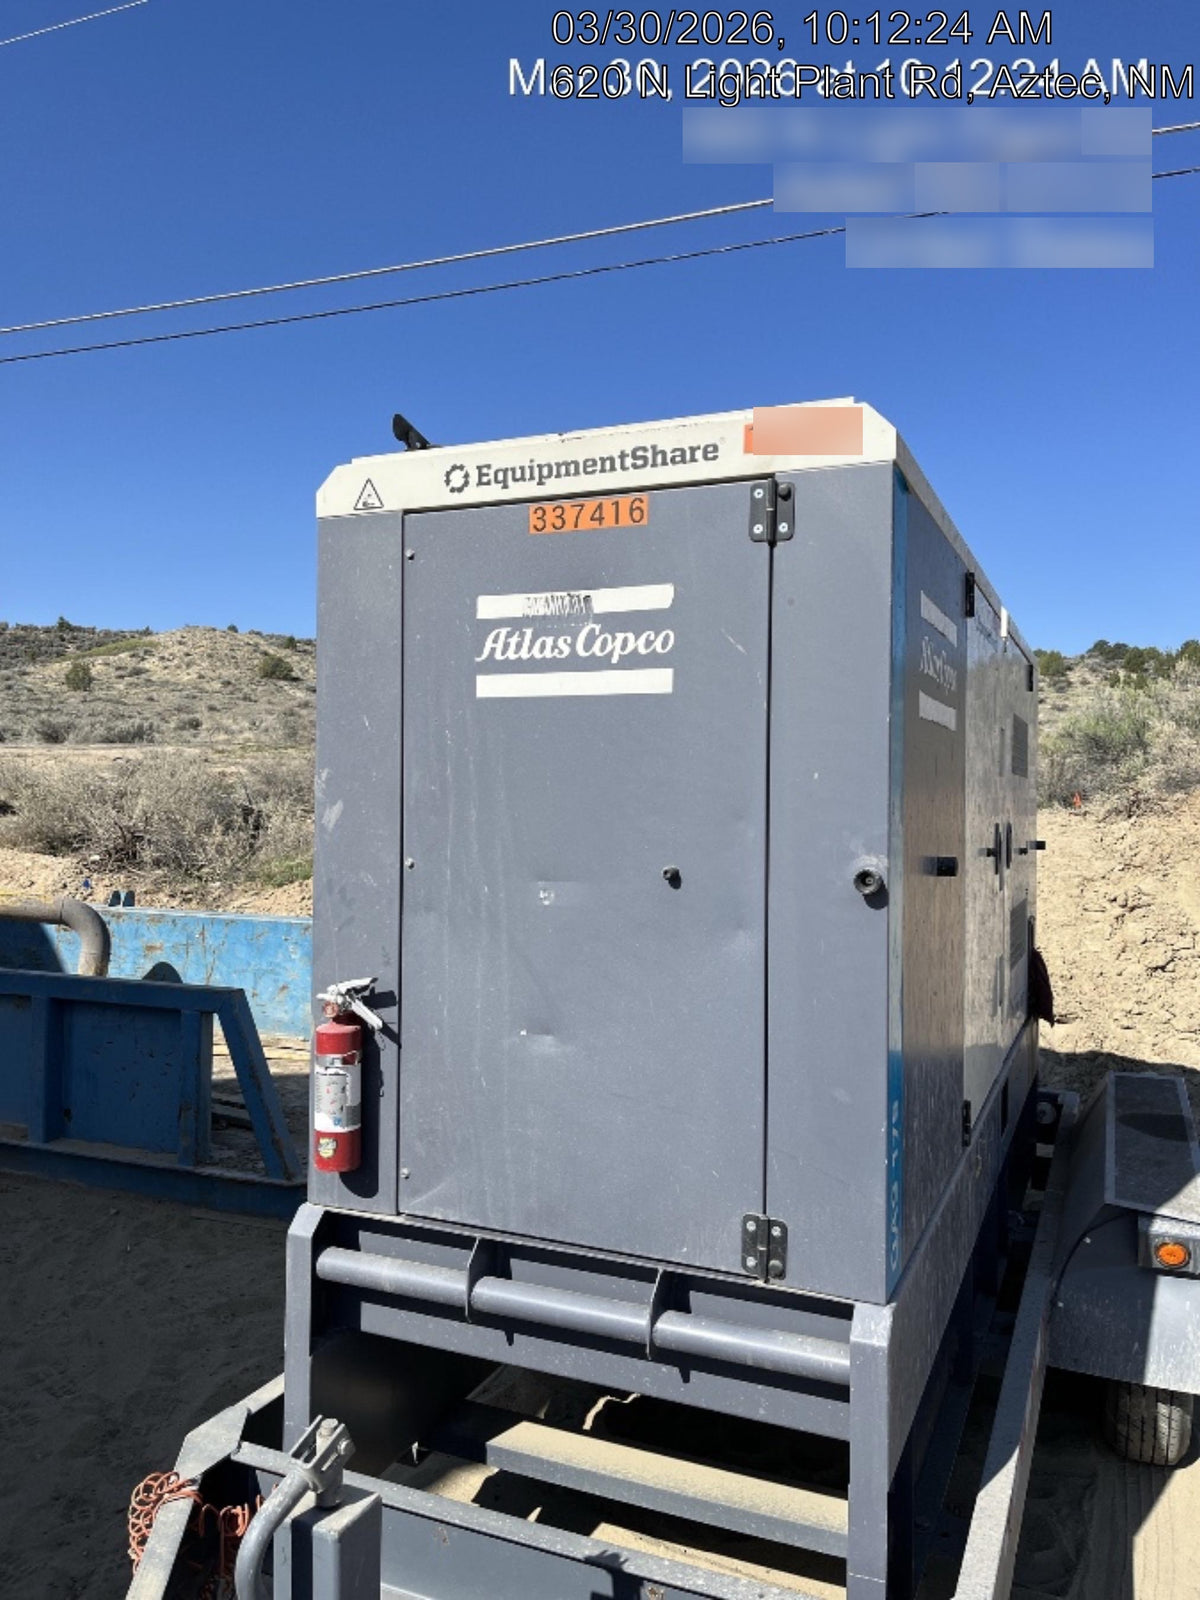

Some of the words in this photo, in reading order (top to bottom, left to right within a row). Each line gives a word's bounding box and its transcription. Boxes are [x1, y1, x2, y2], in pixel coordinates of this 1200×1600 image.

[476, 442, 720, 489] EquipmentShare
[533, 497, 645, 533] 337416
[475, 626, 572, 662] Atlas
[575, 623, 675, 664] Copco
